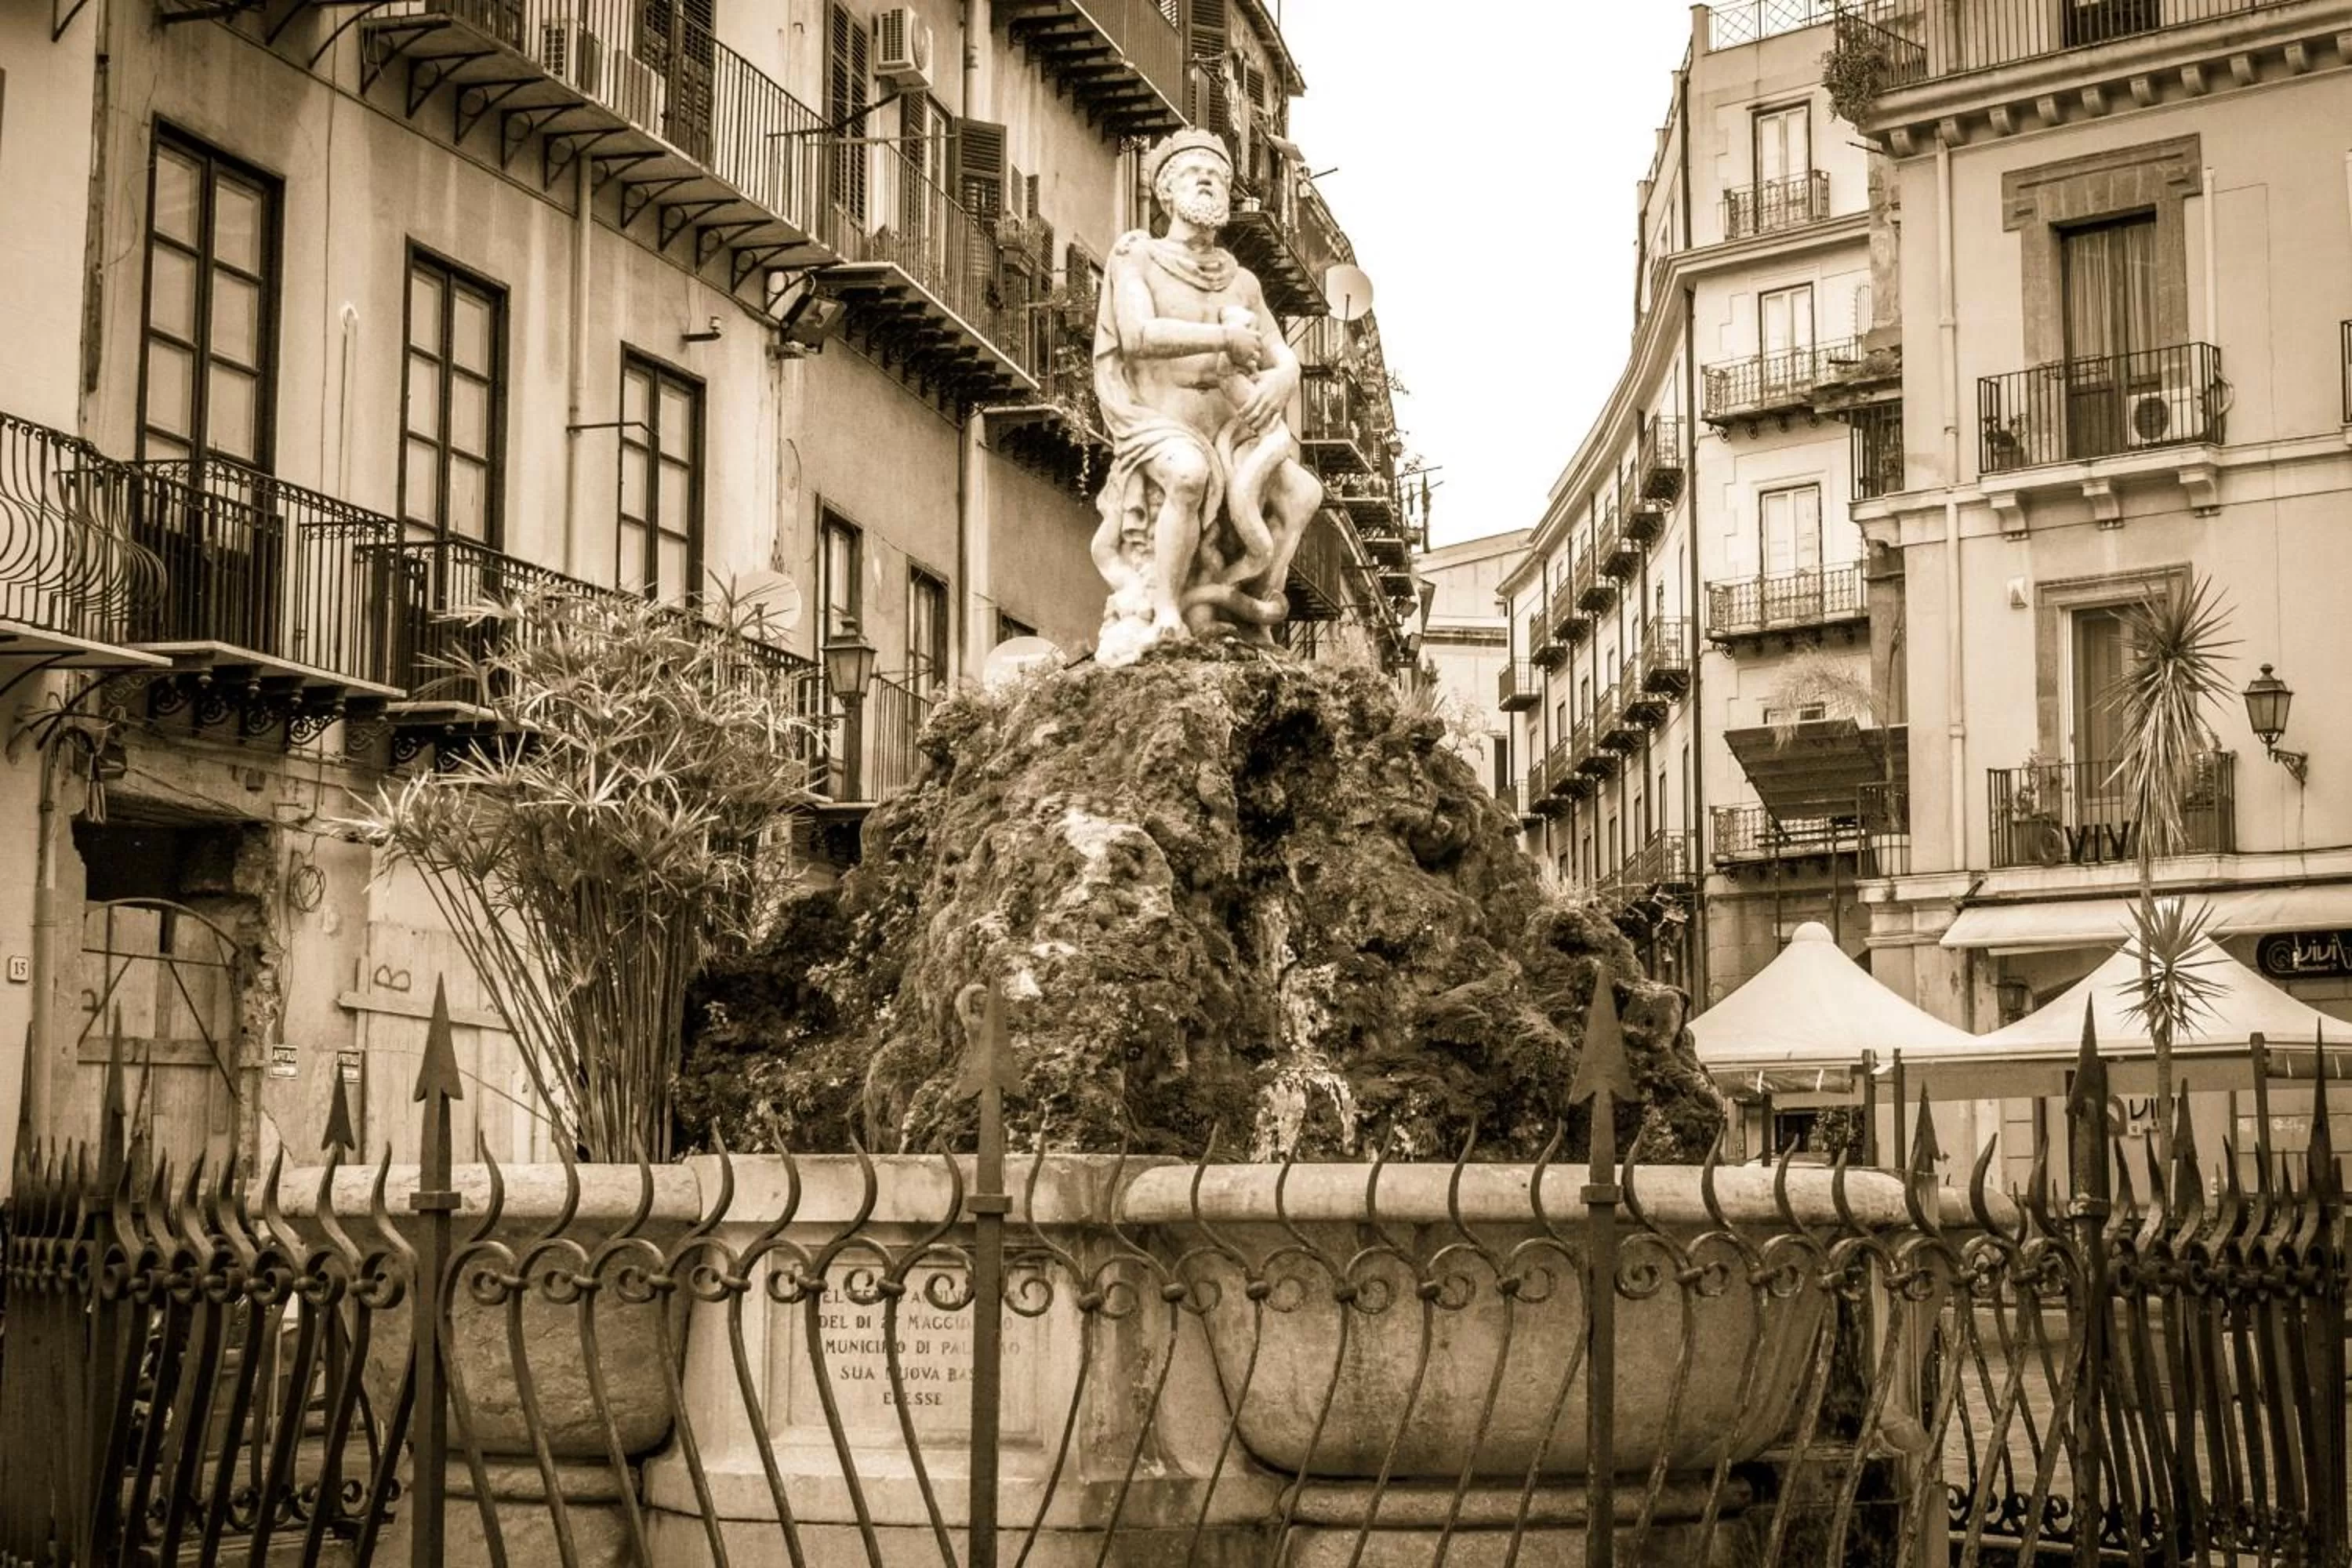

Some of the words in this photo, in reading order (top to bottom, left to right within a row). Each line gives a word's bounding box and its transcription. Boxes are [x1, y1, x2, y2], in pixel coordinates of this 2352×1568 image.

[15, 961, 26, 975] 15
[819, 1315, 848, 1330] DEL
[855, 1315, 871, 1329] DI
[907, 1316, 971, 1330] MAGGIO
[916, 1340, 931, 1354] DI
[840, 1367, 876, 1381] SUA
[883, 1392, 943, 1406] EESSE
